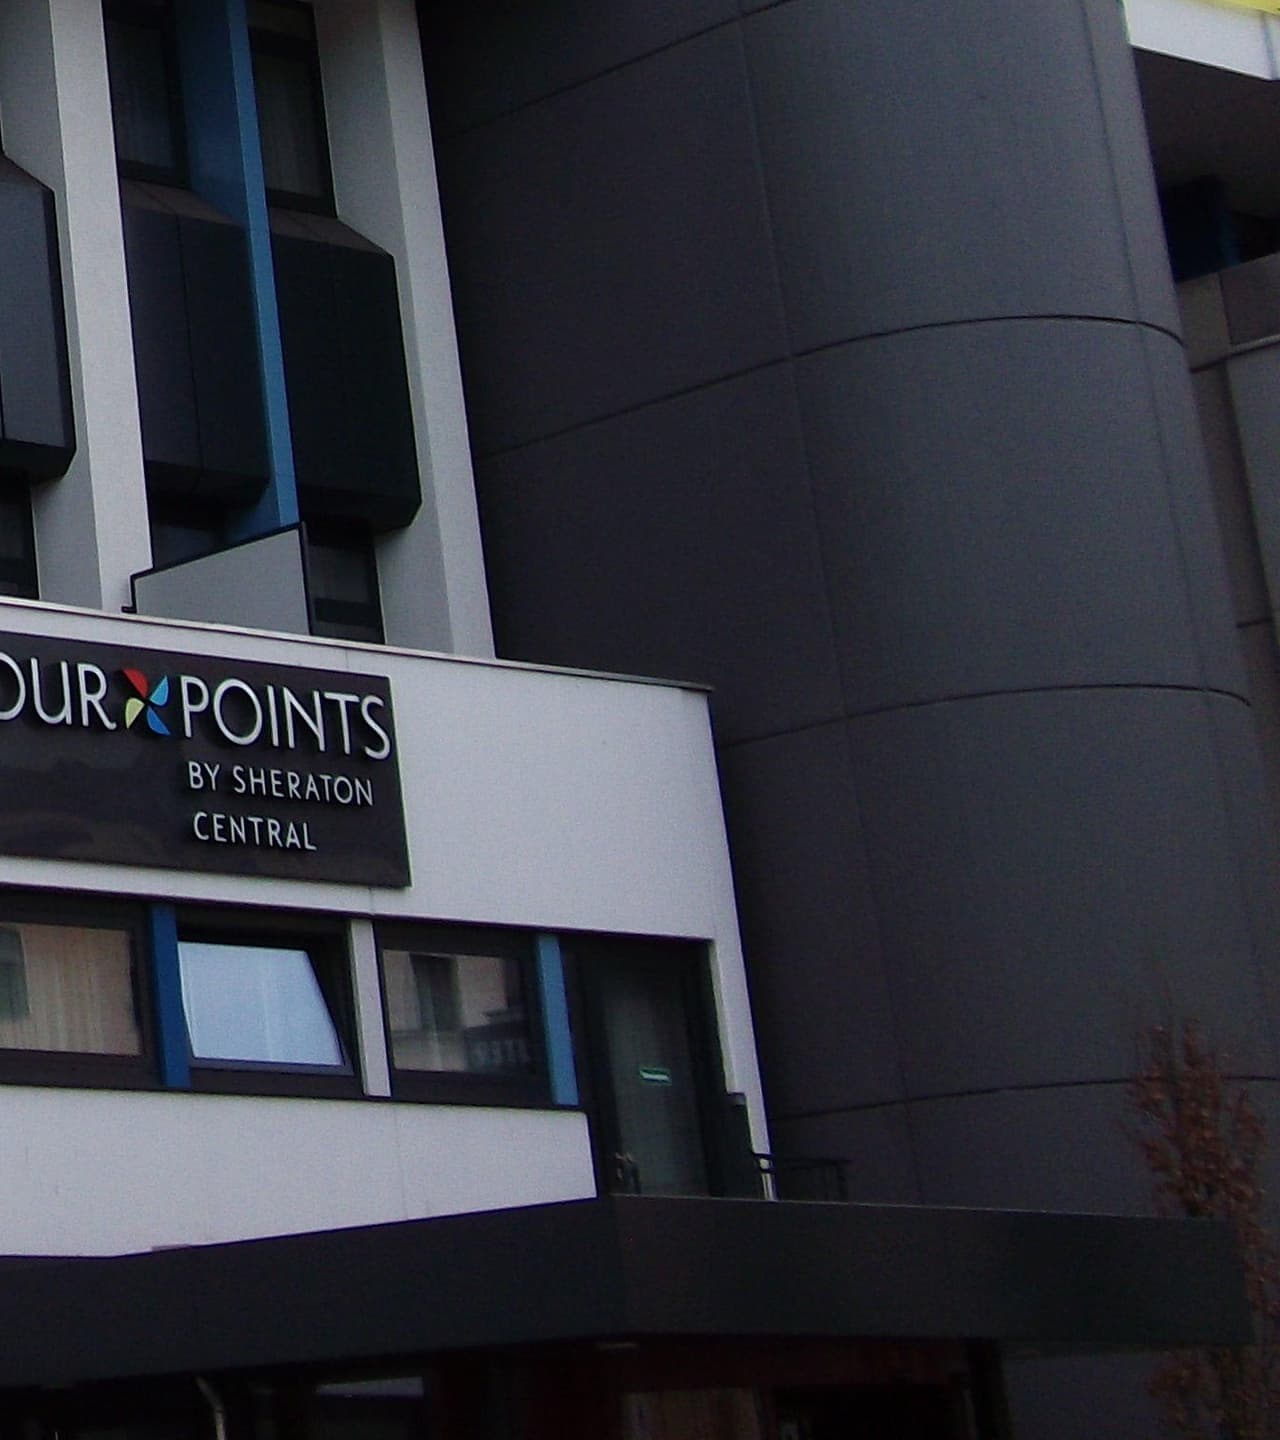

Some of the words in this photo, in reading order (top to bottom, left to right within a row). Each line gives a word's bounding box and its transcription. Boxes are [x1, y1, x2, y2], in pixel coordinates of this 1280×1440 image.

[180, 675, 392, 760] POINTS
[189, 761, 221, 790] BY
[233, 765, 374, 807] SHERATON
[193, 811, 318, 852] CENTRAL
